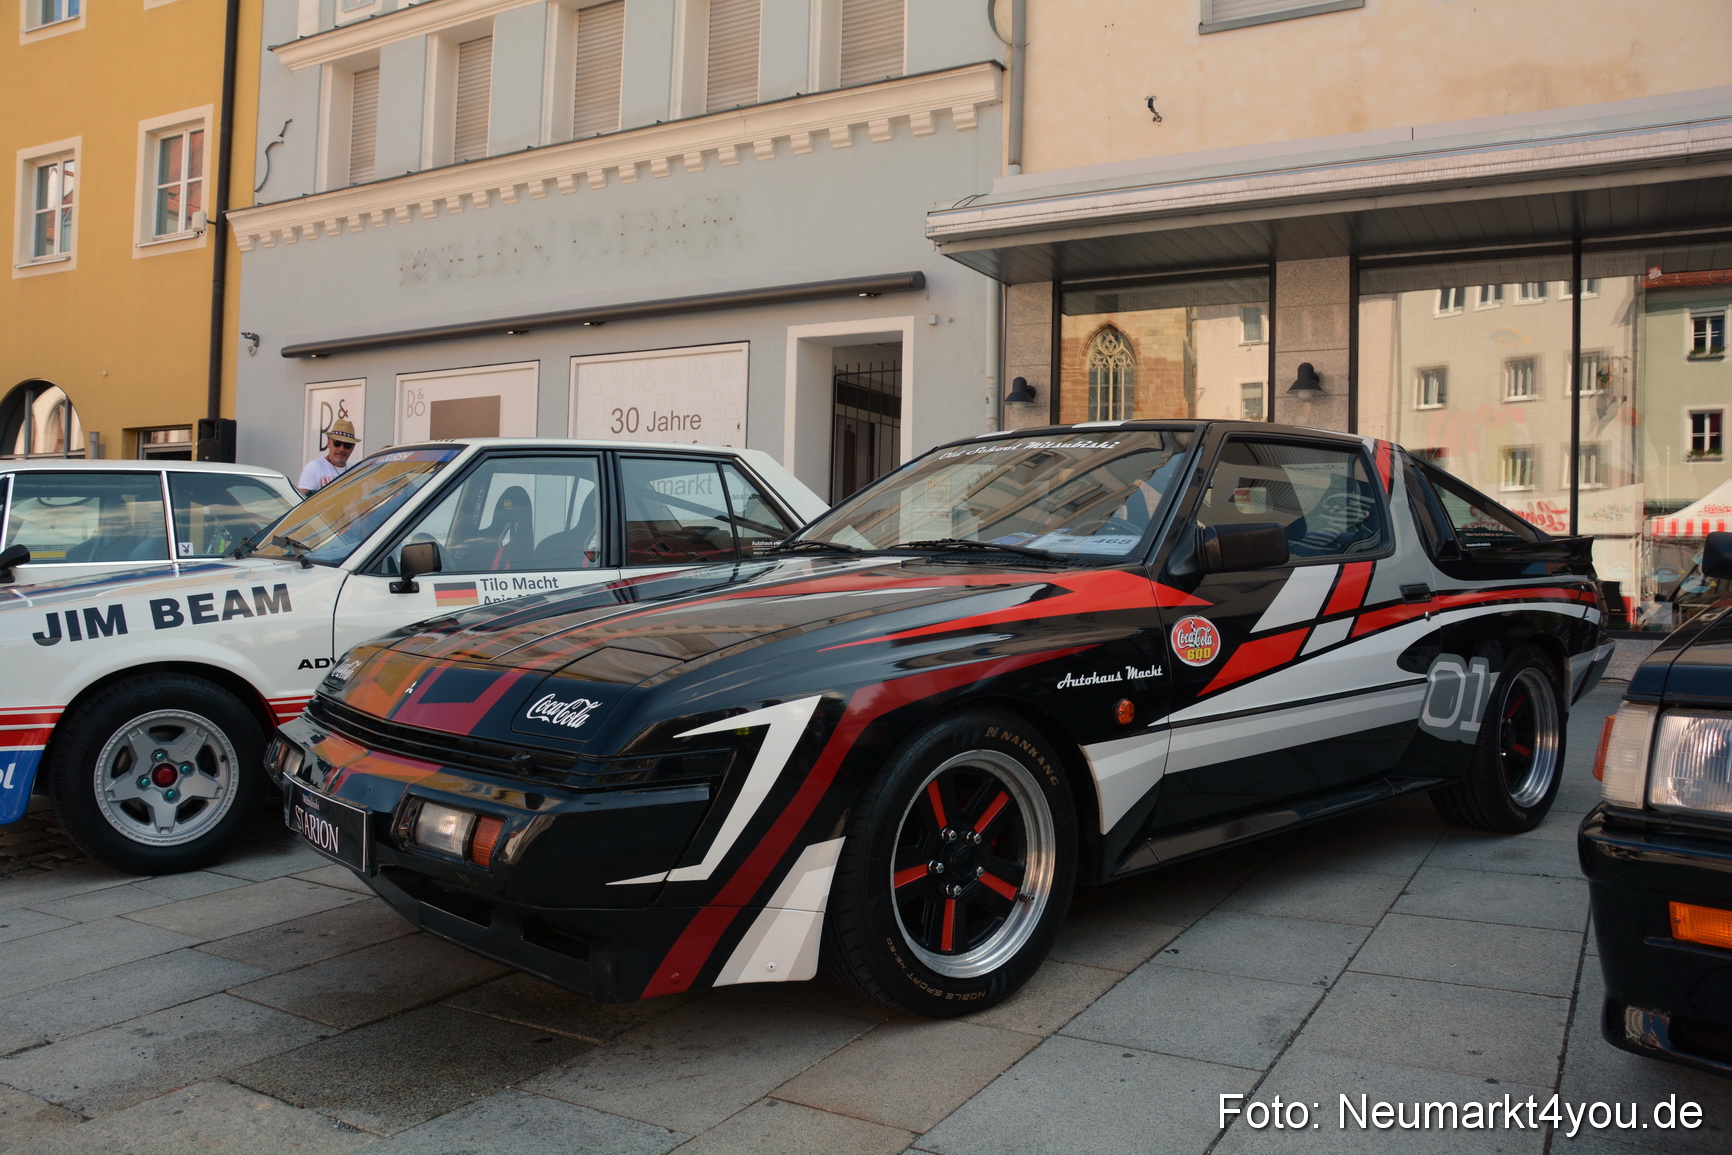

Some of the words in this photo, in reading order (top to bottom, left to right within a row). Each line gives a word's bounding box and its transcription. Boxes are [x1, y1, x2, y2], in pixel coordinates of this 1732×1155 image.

[610, 406, 640, 434] 30
[646, 410, 702, 433] Jahre
[938, 450, 964, 460] Old
[966, 443, 1024, 456] School
[1023, 440, 1121, 450] Mitsubishi
[1092, 538, 1132, 546] 468
[480, 577, 508, 592] Tilo
[512, 576, 559, 591] Macht
[32, 603, 129, 647] JIM
[149, 583, 293, 630] BEAM
[1187, 647, 1212, 660] 600
[1056, 671, 1123, 690] Autohaus
[1125, 664, 1164, 681] Macht
[1421, 660, 1488, 735] 01
[1000, 730, 1060, 786] NANKANG
[295, 804, 339, 854] STARION
[906, 972, 943, 997] SPORT
[945, 990, 986, 1001] NOBLE
